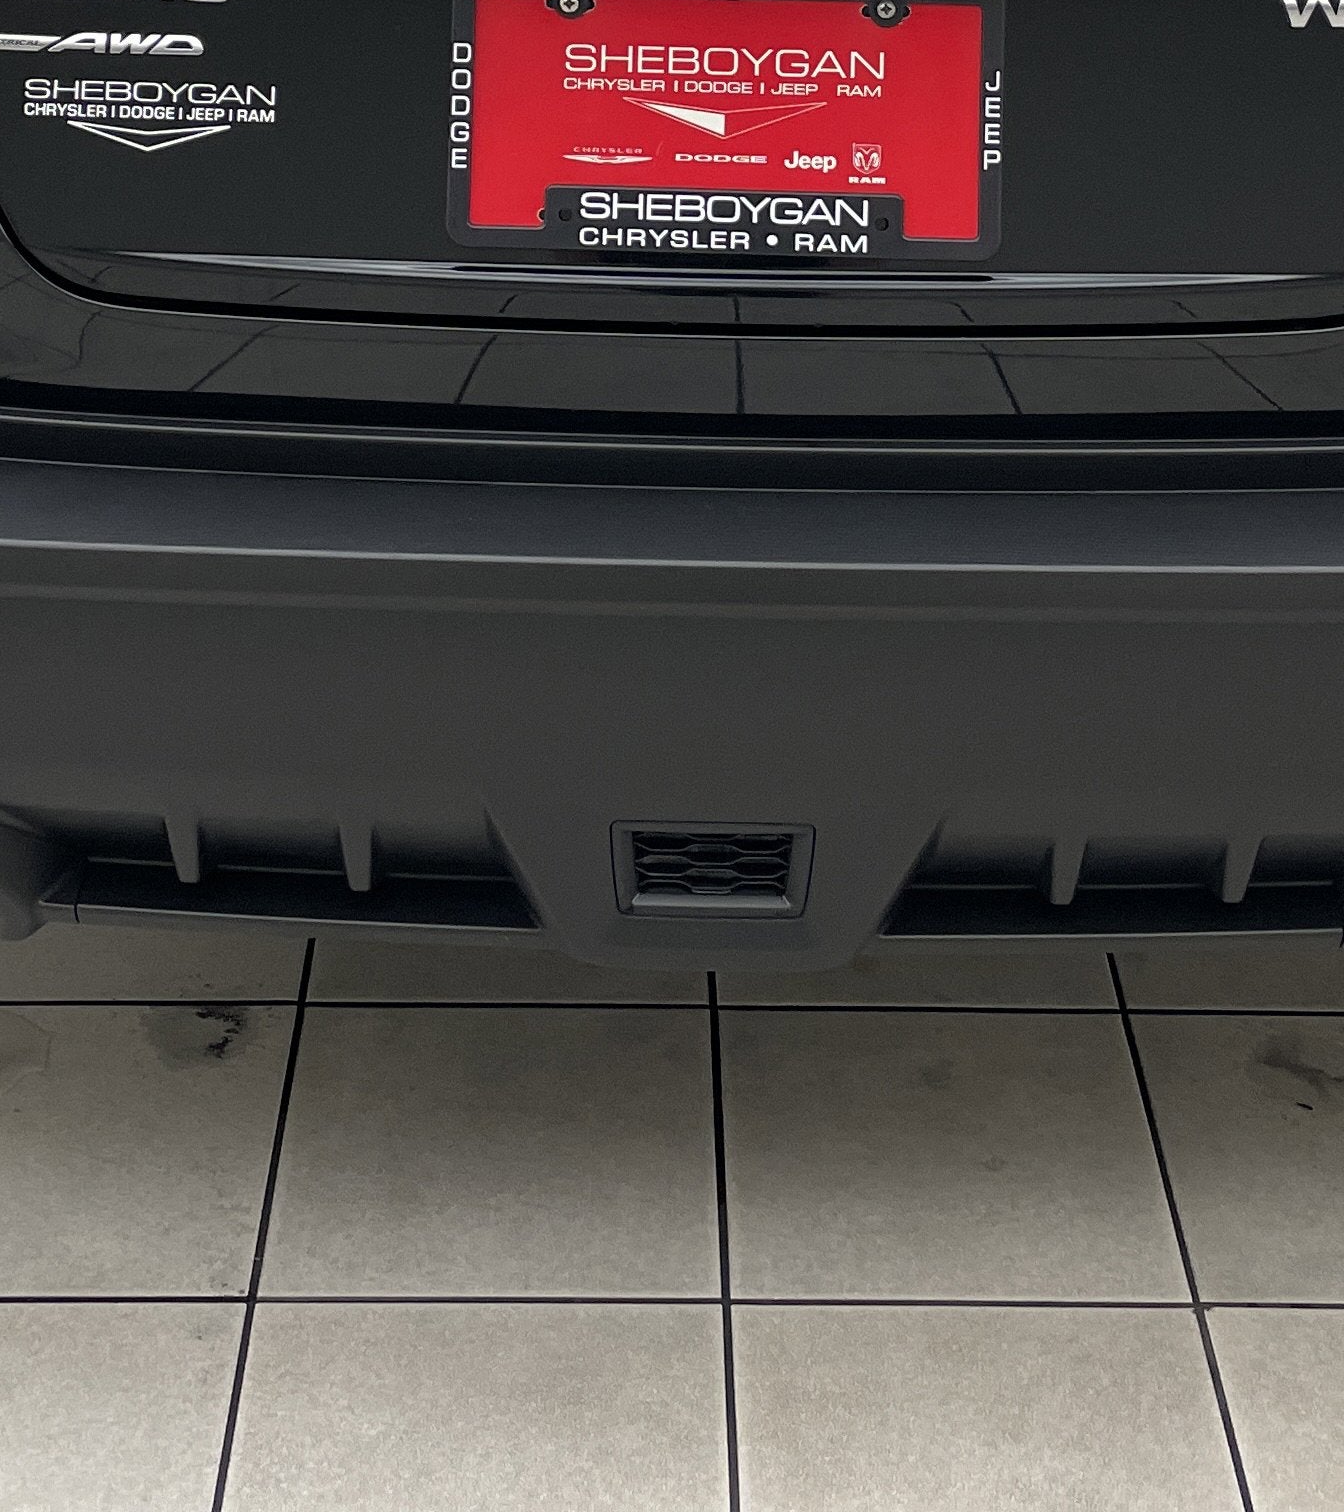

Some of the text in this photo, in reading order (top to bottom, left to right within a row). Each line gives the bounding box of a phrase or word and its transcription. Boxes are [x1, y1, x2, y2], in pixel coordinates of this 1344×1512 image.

[47, 32, 205, 56] AWD
[564, 43, 886, 80] SHEBOYGAN
[23, 78, 276, 106] SHEBOYGAN
[563, 77, 882, 98] CHRYSLER DODGE JEEP RAM
[23, 102, 275, 123] CHRYSLER DODGE JEEP RAM
[572, 145, 643, 154] CHRYSLER
[674, 153, 768, 164] DODGE
[783, 150, 837, 174] Jeep
[848, 176, 886, 185] RAM
[579, 191, 870, 227] SHEBOYGAN
[578, 227, 869, 255] CHRYSLER RAM
